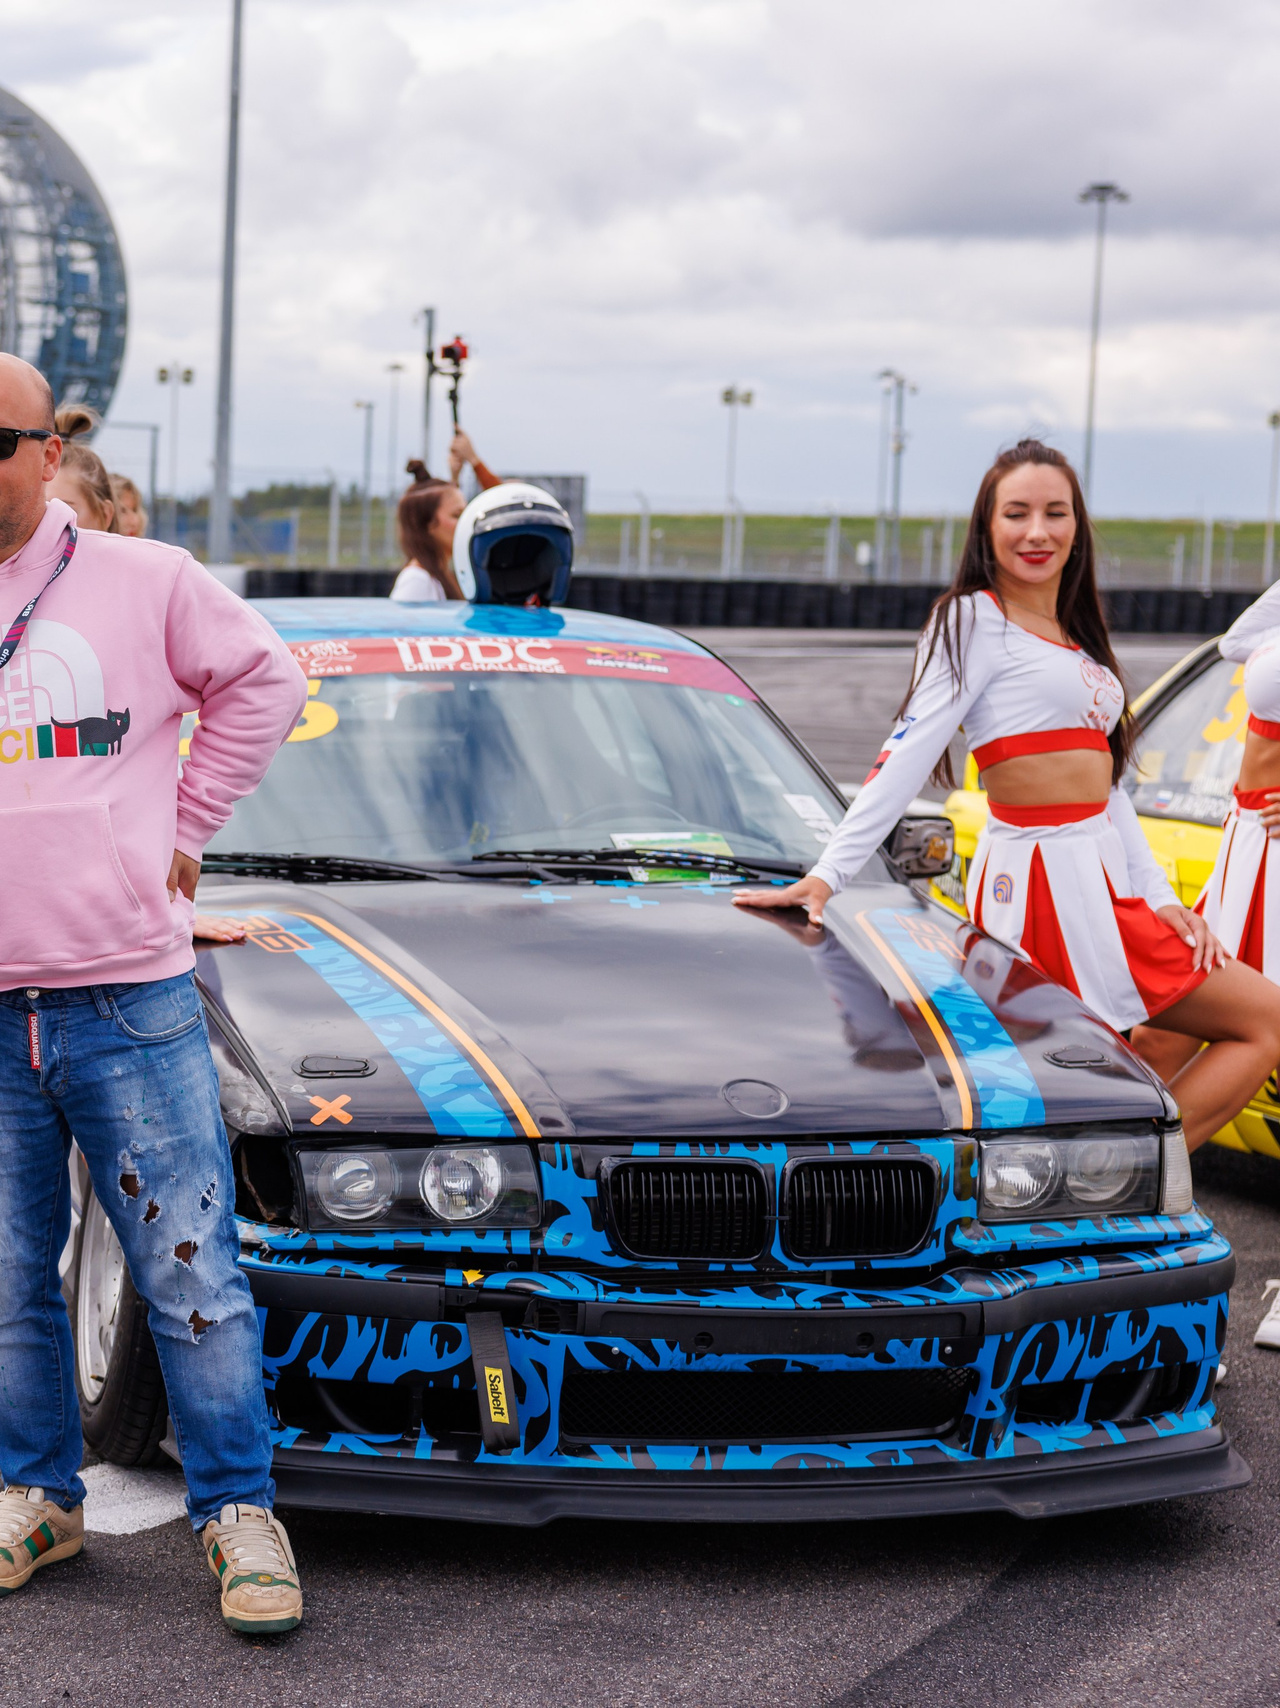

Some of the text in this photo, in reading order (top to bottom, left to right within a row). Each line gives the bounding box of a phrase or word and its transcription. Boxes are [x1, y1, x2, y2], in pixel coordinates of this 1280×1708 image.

[394, 640, 560, 665] IDDC
[403, 662, 566, 673] DRIFT CHALLENGE
[30, 1015, 40, 1067] DSQUARED2
[488, 1373, 505, 1417] Sabelt
